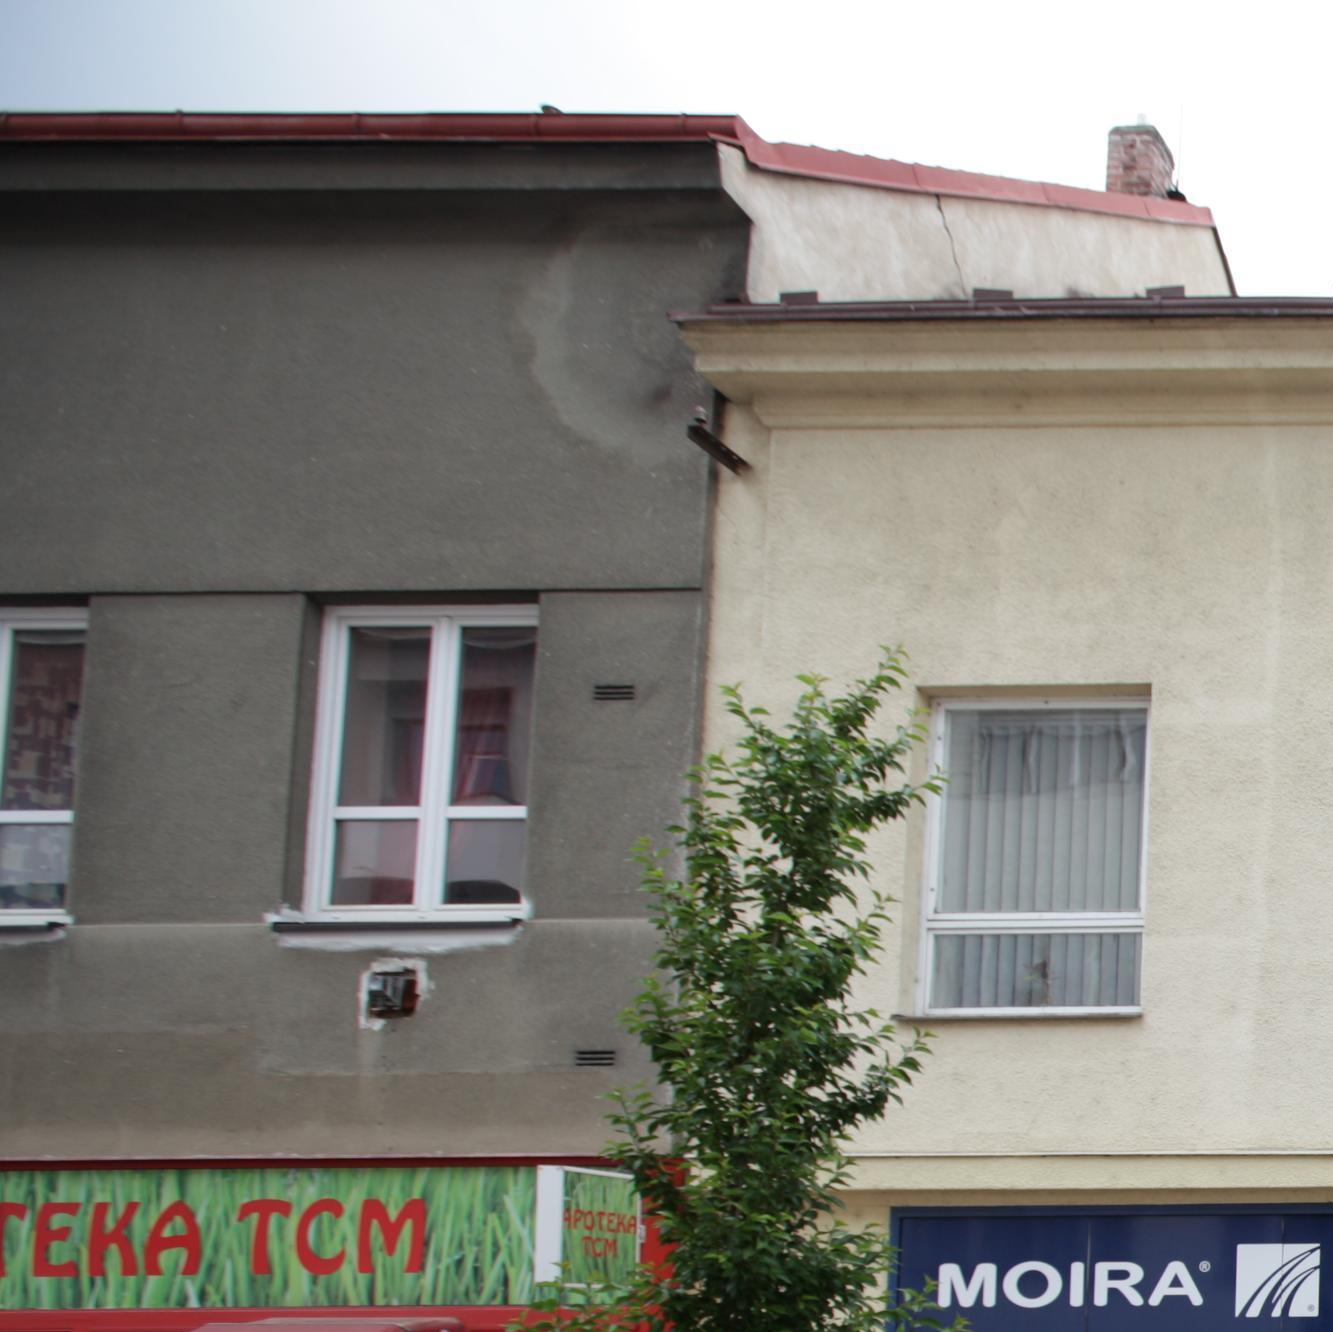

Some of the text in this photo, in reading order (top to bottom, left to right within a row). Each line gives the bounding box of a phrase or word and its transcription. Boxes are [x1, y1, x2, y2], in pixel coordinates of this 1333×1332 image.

[563, 1208, 637, 1234] APOTEKA
[237, 1198, 427, 1275] TCM
[582, 1235, 619, 1258] TCM
